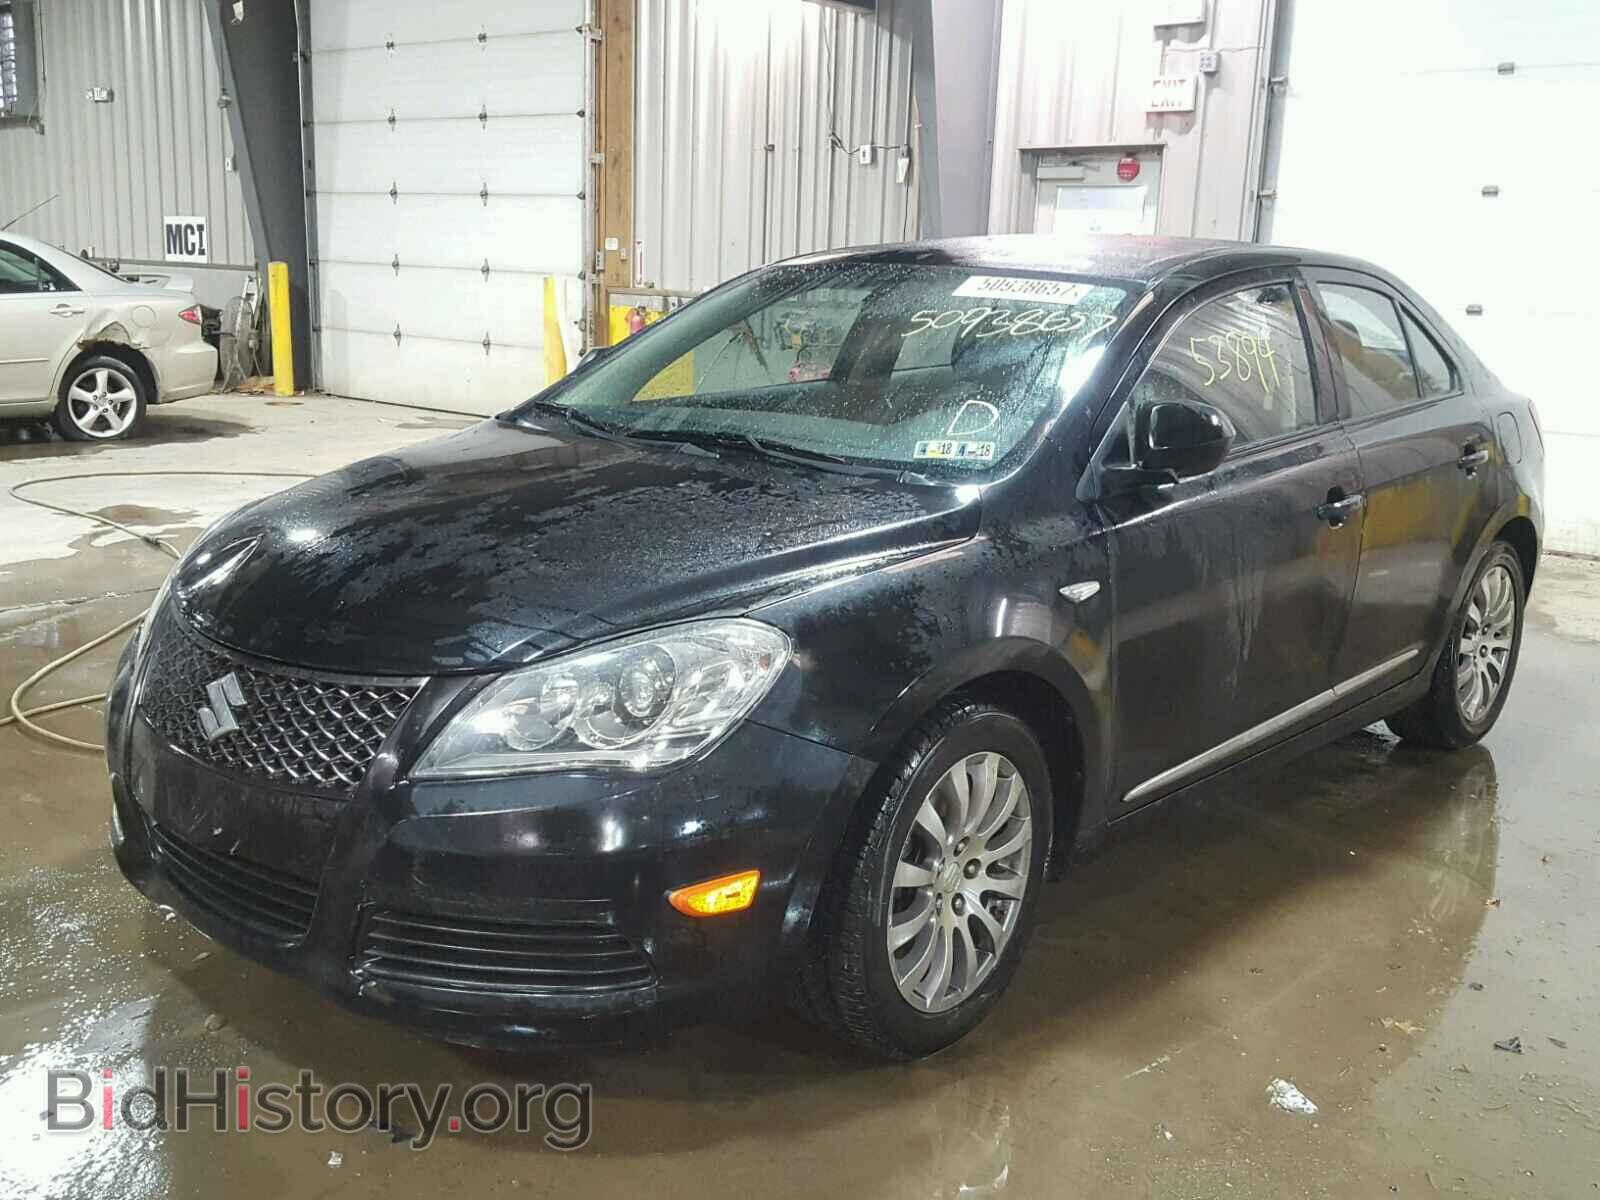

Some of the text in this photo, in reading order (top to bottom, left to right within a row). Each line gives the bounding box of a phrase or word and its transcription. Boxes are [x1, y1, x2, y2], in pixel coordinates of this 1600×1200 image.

[166, 223, 206, 256] MCI
[900, 307, 1118, 344] 50938657
[1189, 328, 1281, 393] 53894
[946, 399, 1000, 436] D
